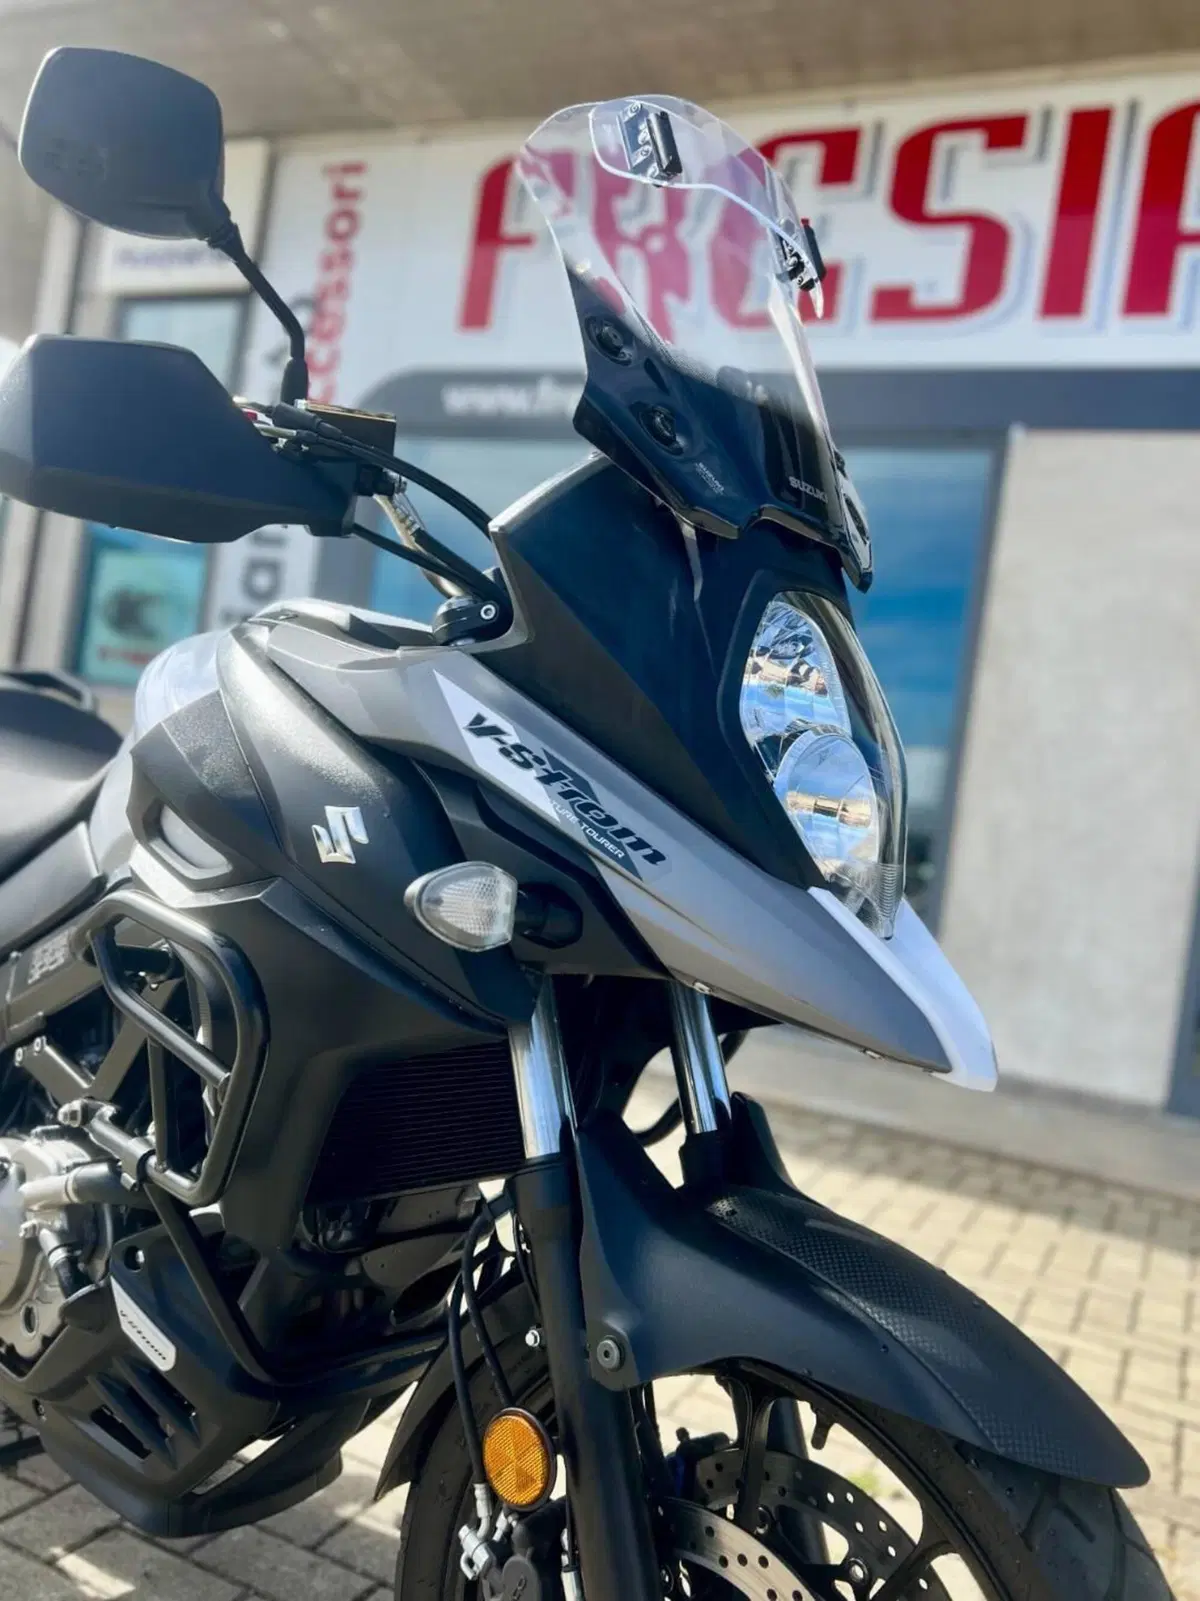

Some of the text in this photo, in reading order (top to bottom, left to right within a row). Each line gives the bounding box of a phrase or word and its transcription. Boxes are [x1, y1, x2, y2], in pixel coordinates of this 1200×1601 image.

[788, 475, 829, 504] SUZUKI
[463, 712, 667, 866] V-Strom
[580, 822, 626, 858] TOURER
